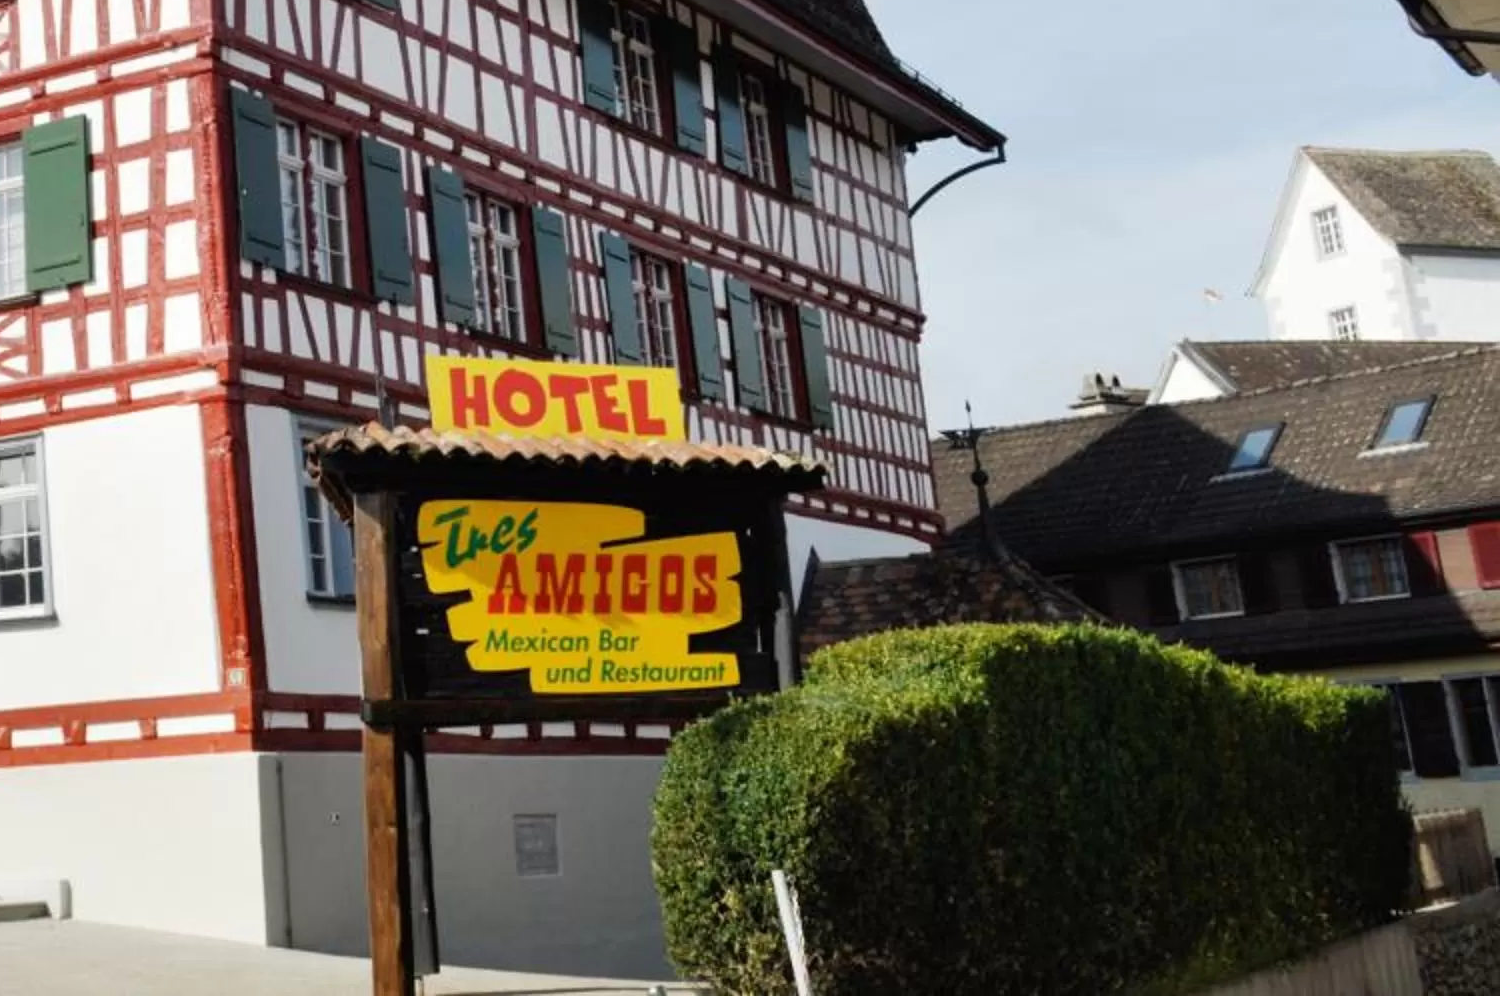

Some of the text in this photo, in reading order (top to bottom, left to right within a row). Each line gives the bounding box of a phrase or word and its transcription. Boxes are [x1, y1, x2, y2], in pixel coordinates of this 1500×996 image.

[449, 367, 667, 436] HOTEL
[432, 507, 539, 569] Tres
[487, 552, 718, 616] AMIGOS
[485, 628, 640, 653] Mexican Bar
[546, 657, 726, 684] und Restaurant
